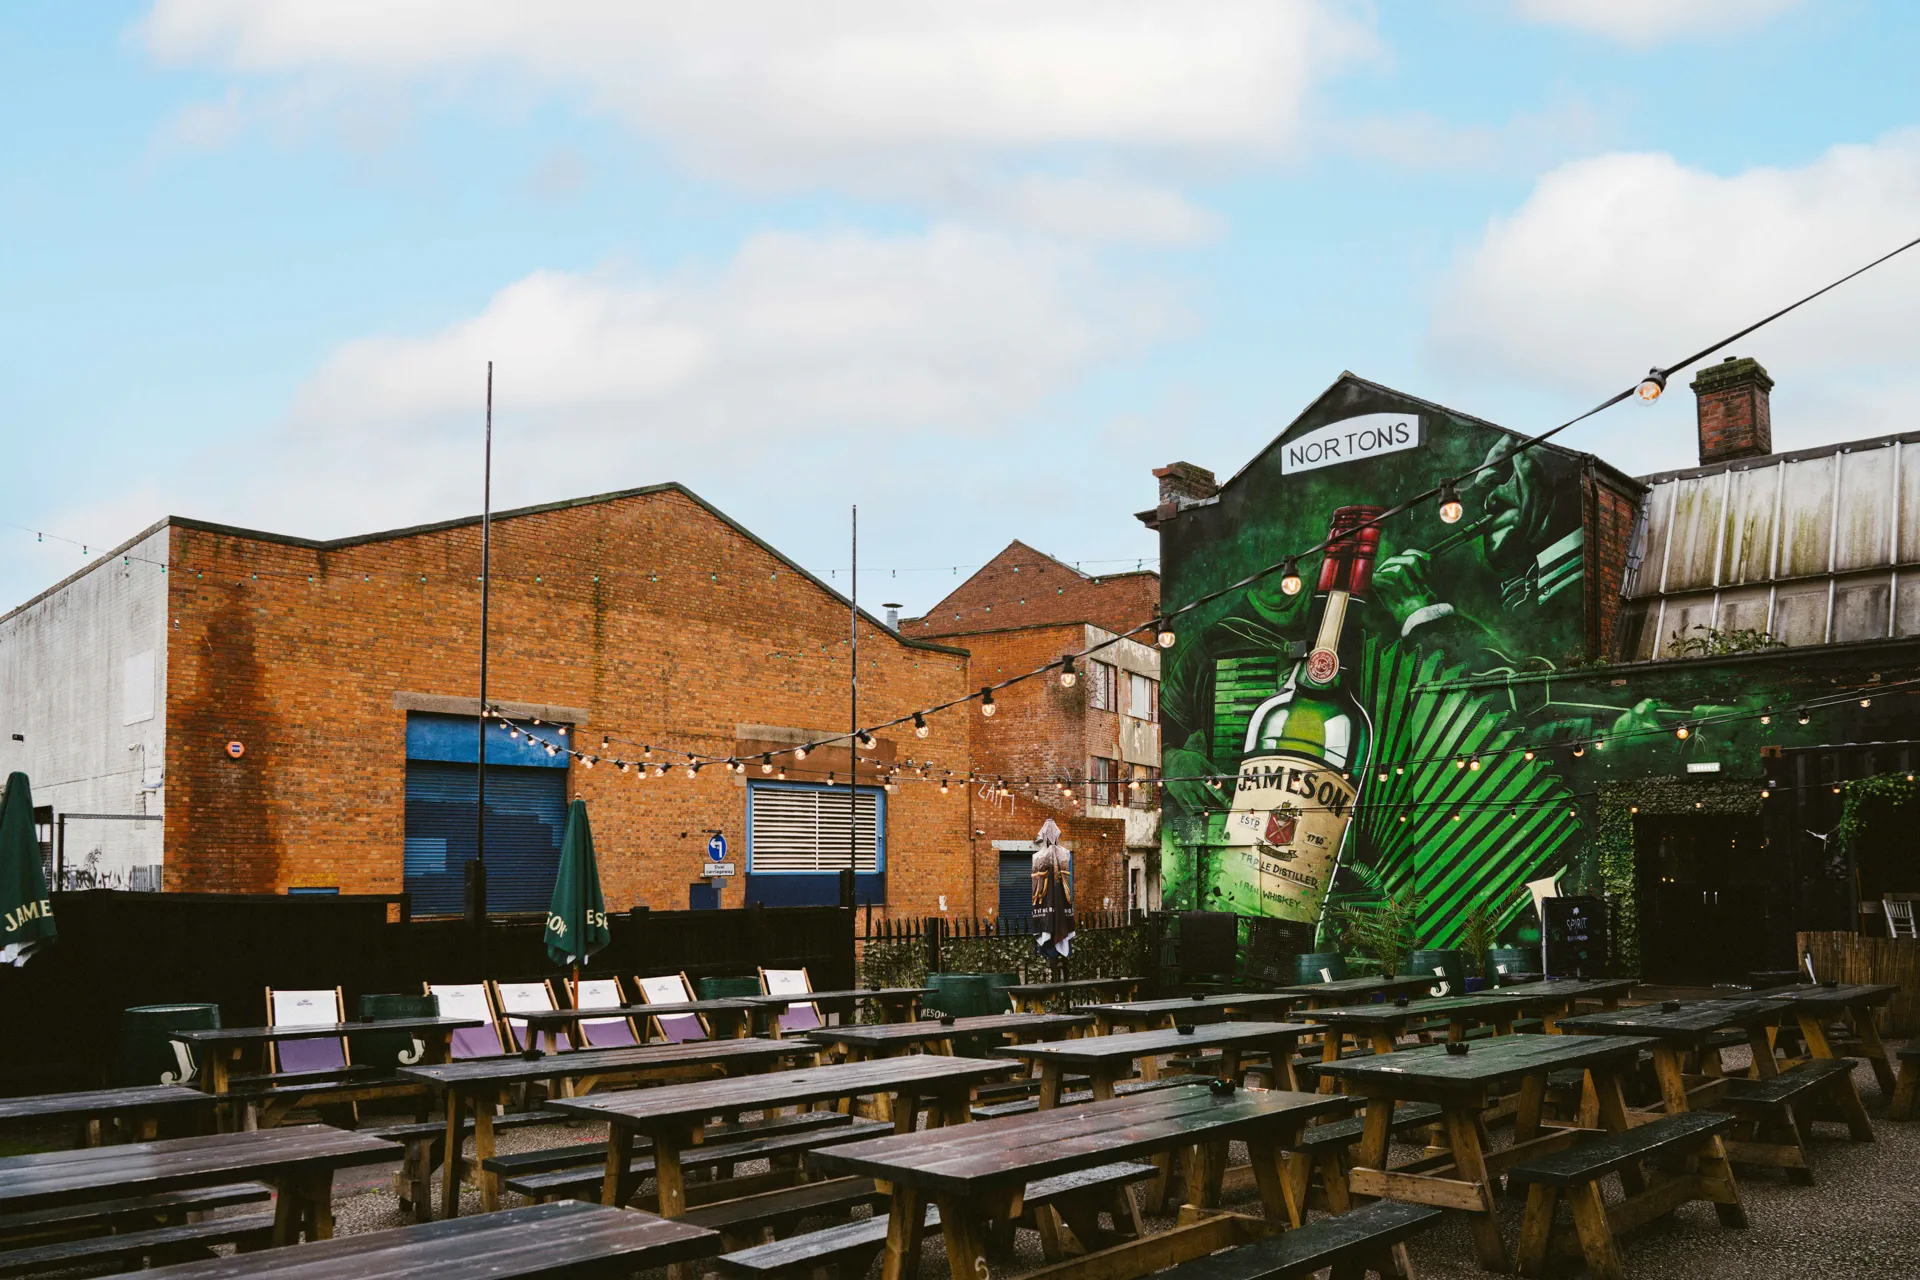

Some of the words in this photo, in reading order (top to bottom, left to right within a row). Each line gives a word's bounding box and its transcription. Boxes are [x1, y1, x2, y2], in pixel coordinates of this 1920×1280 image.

[1290, 422, 1410, 467] NORTONS
[1238, 765, 1351, 819] JAMESON
[1272, 864, 1318, 888] DISTILLED
[1262, 890, 1301, 908] WHISKEY
